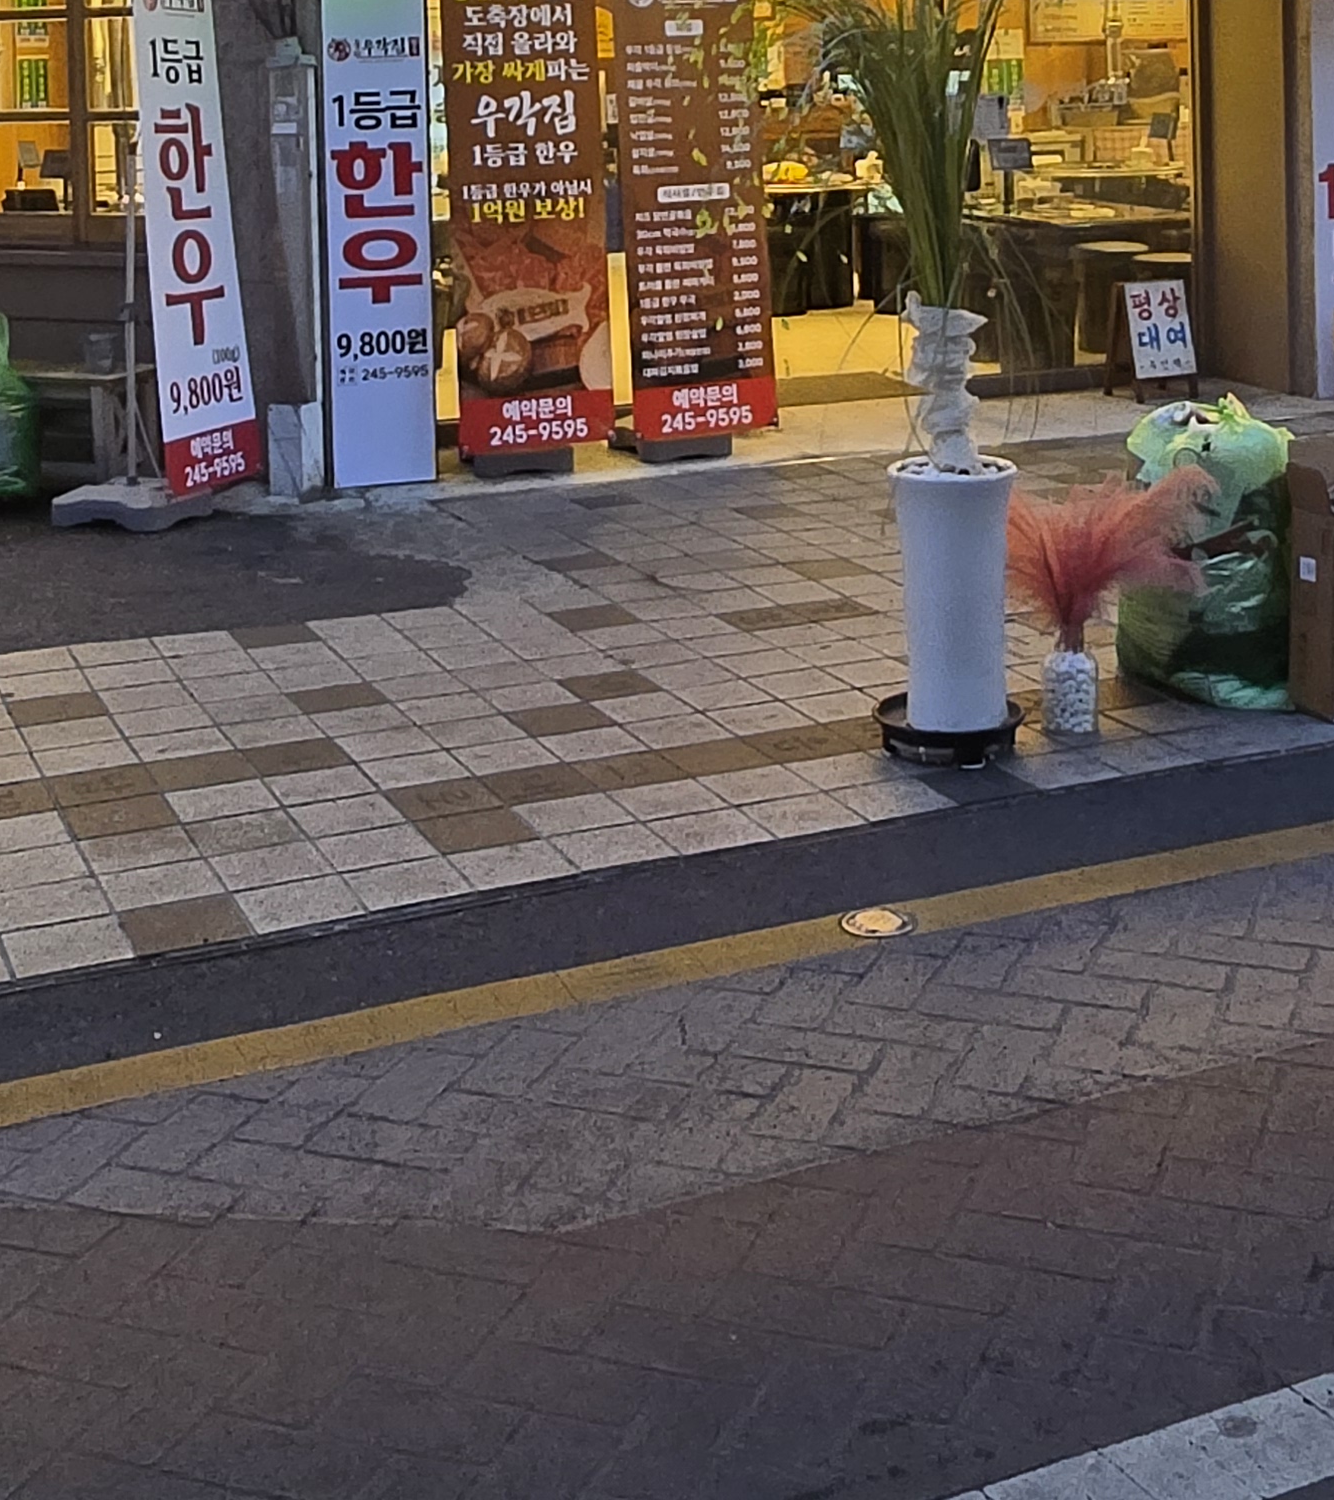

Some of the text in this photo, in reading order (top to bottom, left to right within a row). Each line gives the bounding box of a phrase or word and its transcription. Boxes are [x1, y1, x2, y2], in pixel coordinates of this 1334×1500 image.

[463, 2, 573, 29] 도축장에서
[461, 30, 579, 57] 직접 올라와
[149, 36, 205, 85] 1등급
[451, 59, 496, 85] 가장
[331, 89, 422, 131] 1등급
[469, 88, 578, 140] 우각집
[471, 140, 579, 169] 1등급 한우
[461, 178, 594, 201] 1등급 한우가 아닐시
[153, 101, 226, 347] 한우
[329, 139, 424, 305] 한우
[470, 196, 586, 225] 1억원 보상!
[1129, 287, 1182, 321] 평상
[336, 327, 429, 363] 9,800원
[1137, 321, 1188, 353] 대여
[361, 363, 430, 382] 245-9595
[169, 365, 244, 416] 9,800원
[670, 384, 740, 410] 예약문의
[501, 395, 574, 422] 예약문의
[660, 405, 755, 434] 245-9595
[189, 427, 235, 460] 예약문의
[488, 420, 590, 449] 245-9595
[184, 451, 247, 489] 245-9595
